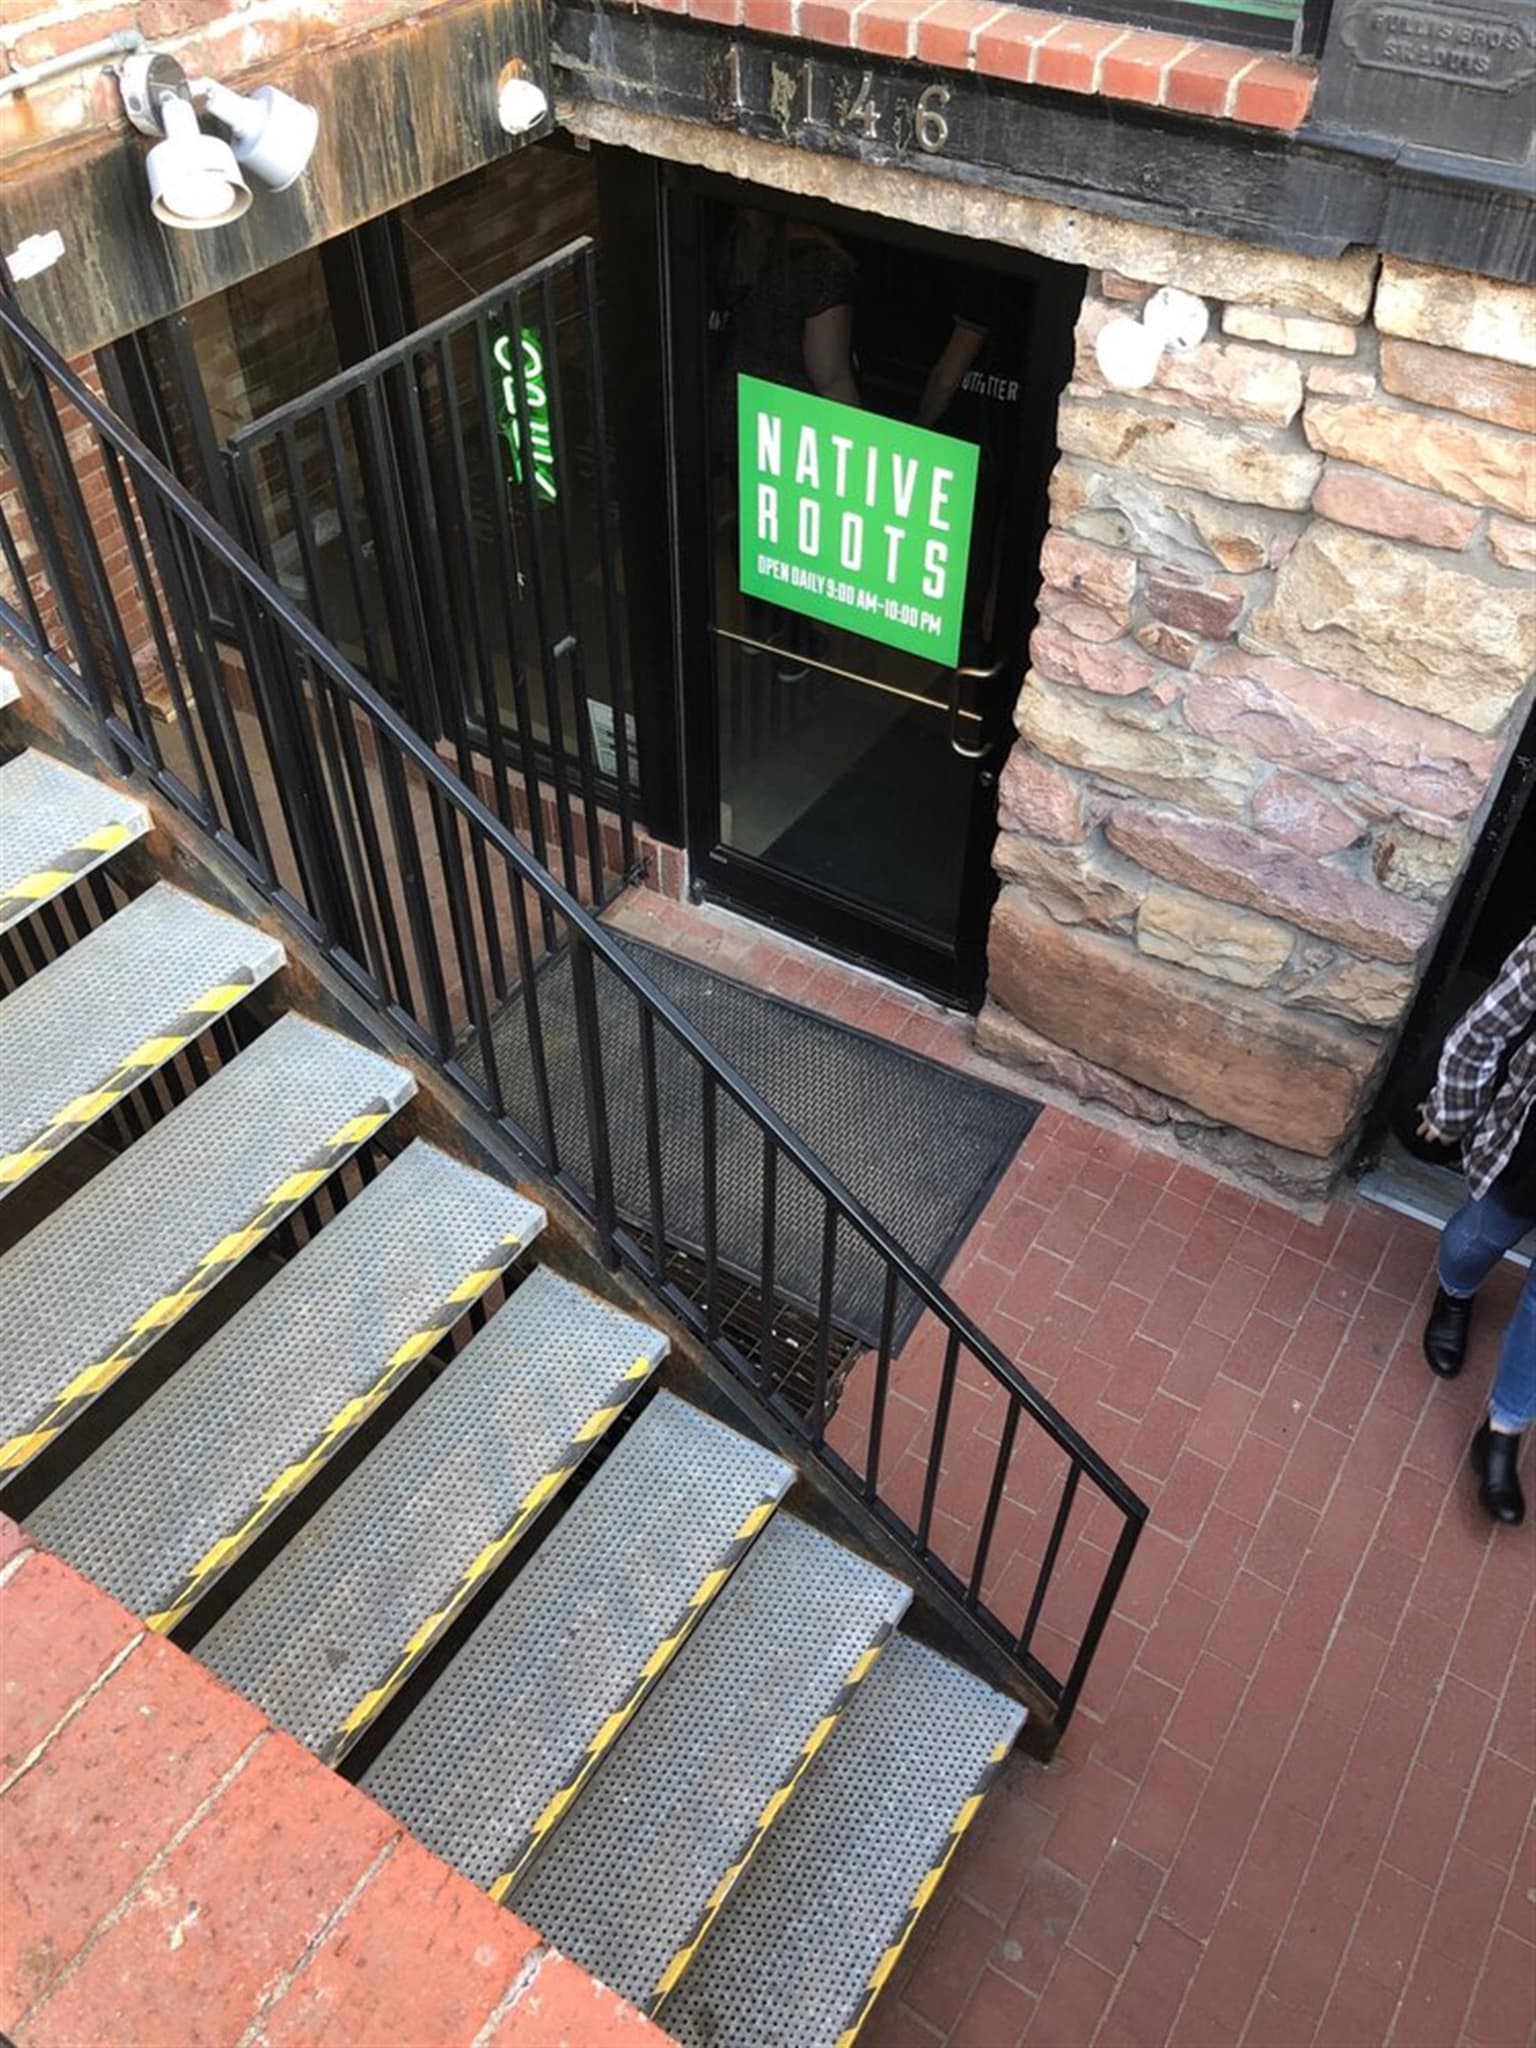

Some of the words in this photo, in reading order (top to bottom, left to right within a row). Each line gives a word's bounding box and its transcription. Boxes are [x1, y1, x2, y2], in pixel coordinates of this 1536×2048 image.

[724, 42, 951, 153] 1146
[757, 412, 954, 531] NATIVE
[757, 483, 949, 600] ROOTS
[757, 554, 789, 583] OPEN
[791, 565, 826, 595] DAILY
[826, 578, 855, 606] 9:00
[920, 610, 942, 637] PM
